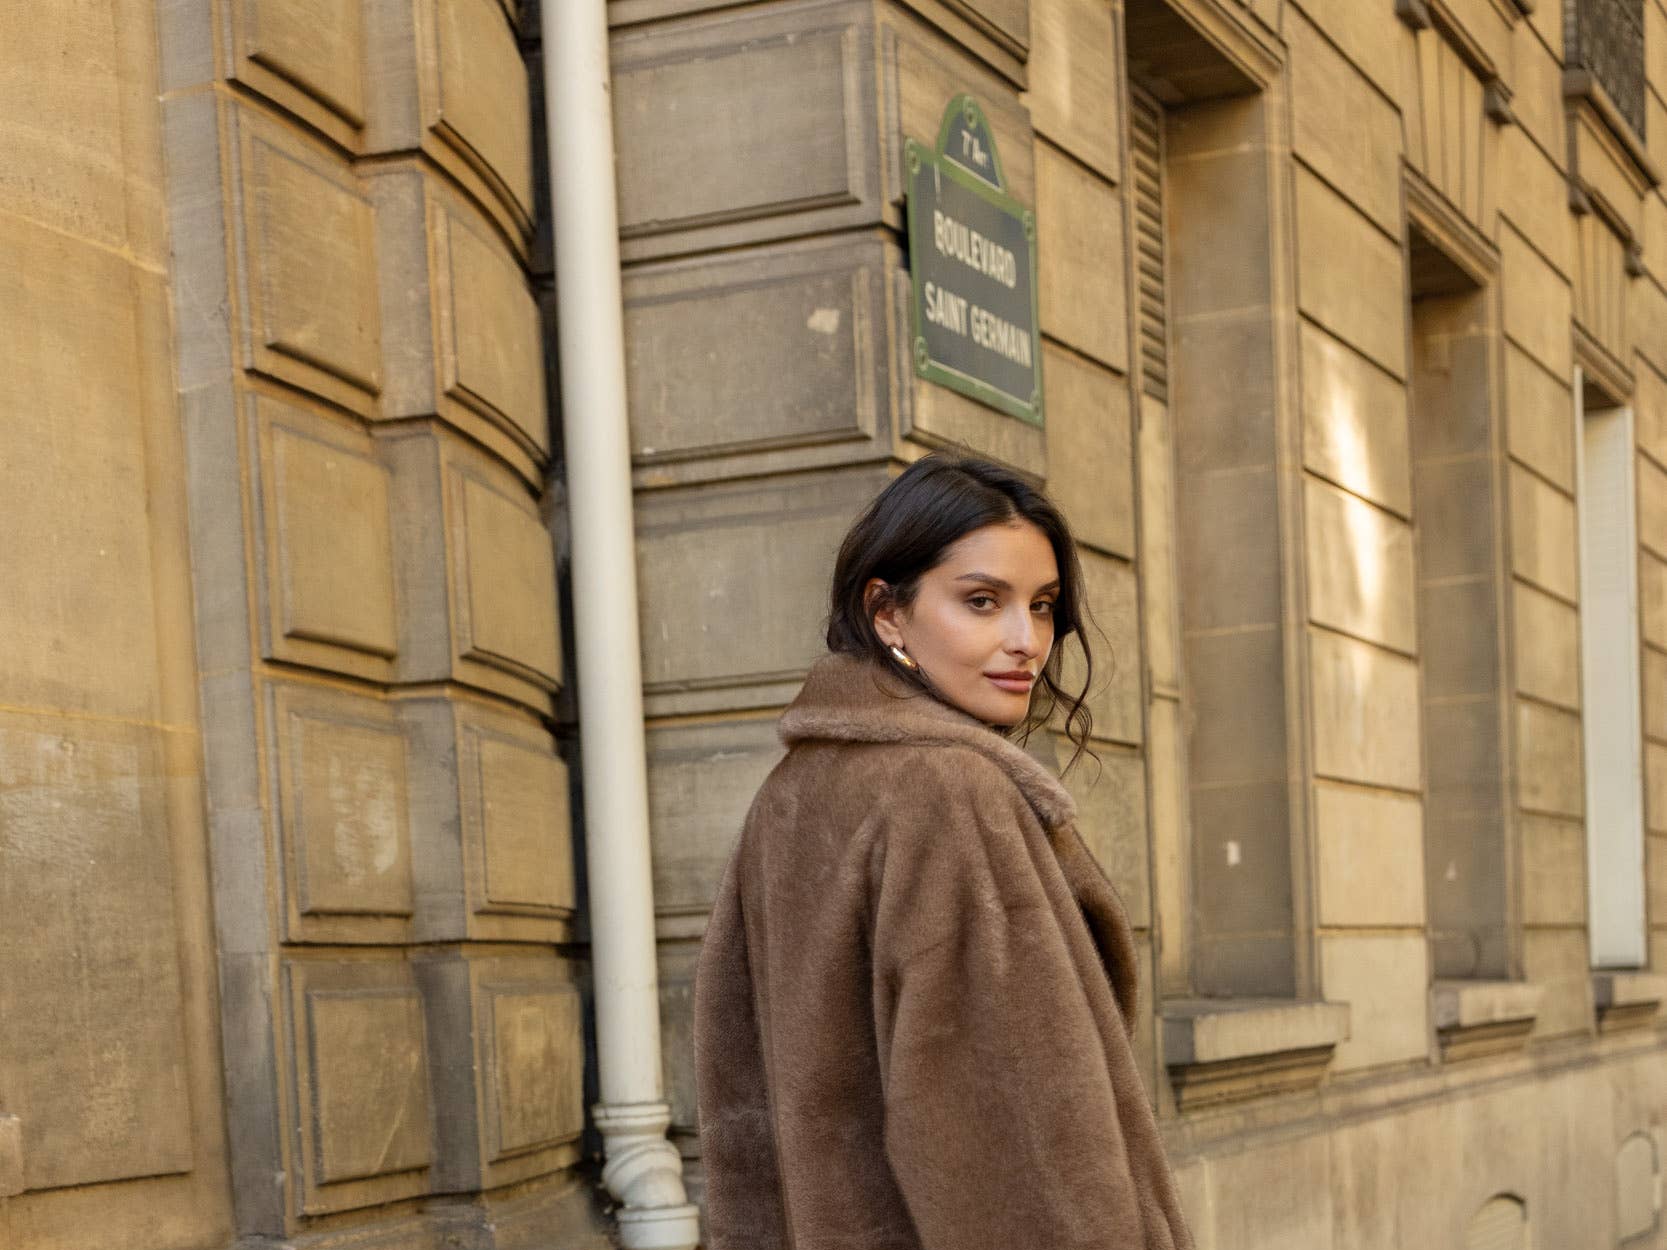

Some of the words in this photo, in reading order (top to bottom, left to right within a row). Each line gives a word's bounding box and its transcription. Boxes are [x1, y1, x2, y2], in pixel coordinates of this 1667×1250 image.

[934, 210, 1016, 288] BOULEVARD
[925, 281, 967, 337] SAINT
[970, 304, 1032, 368] GERMAIN
